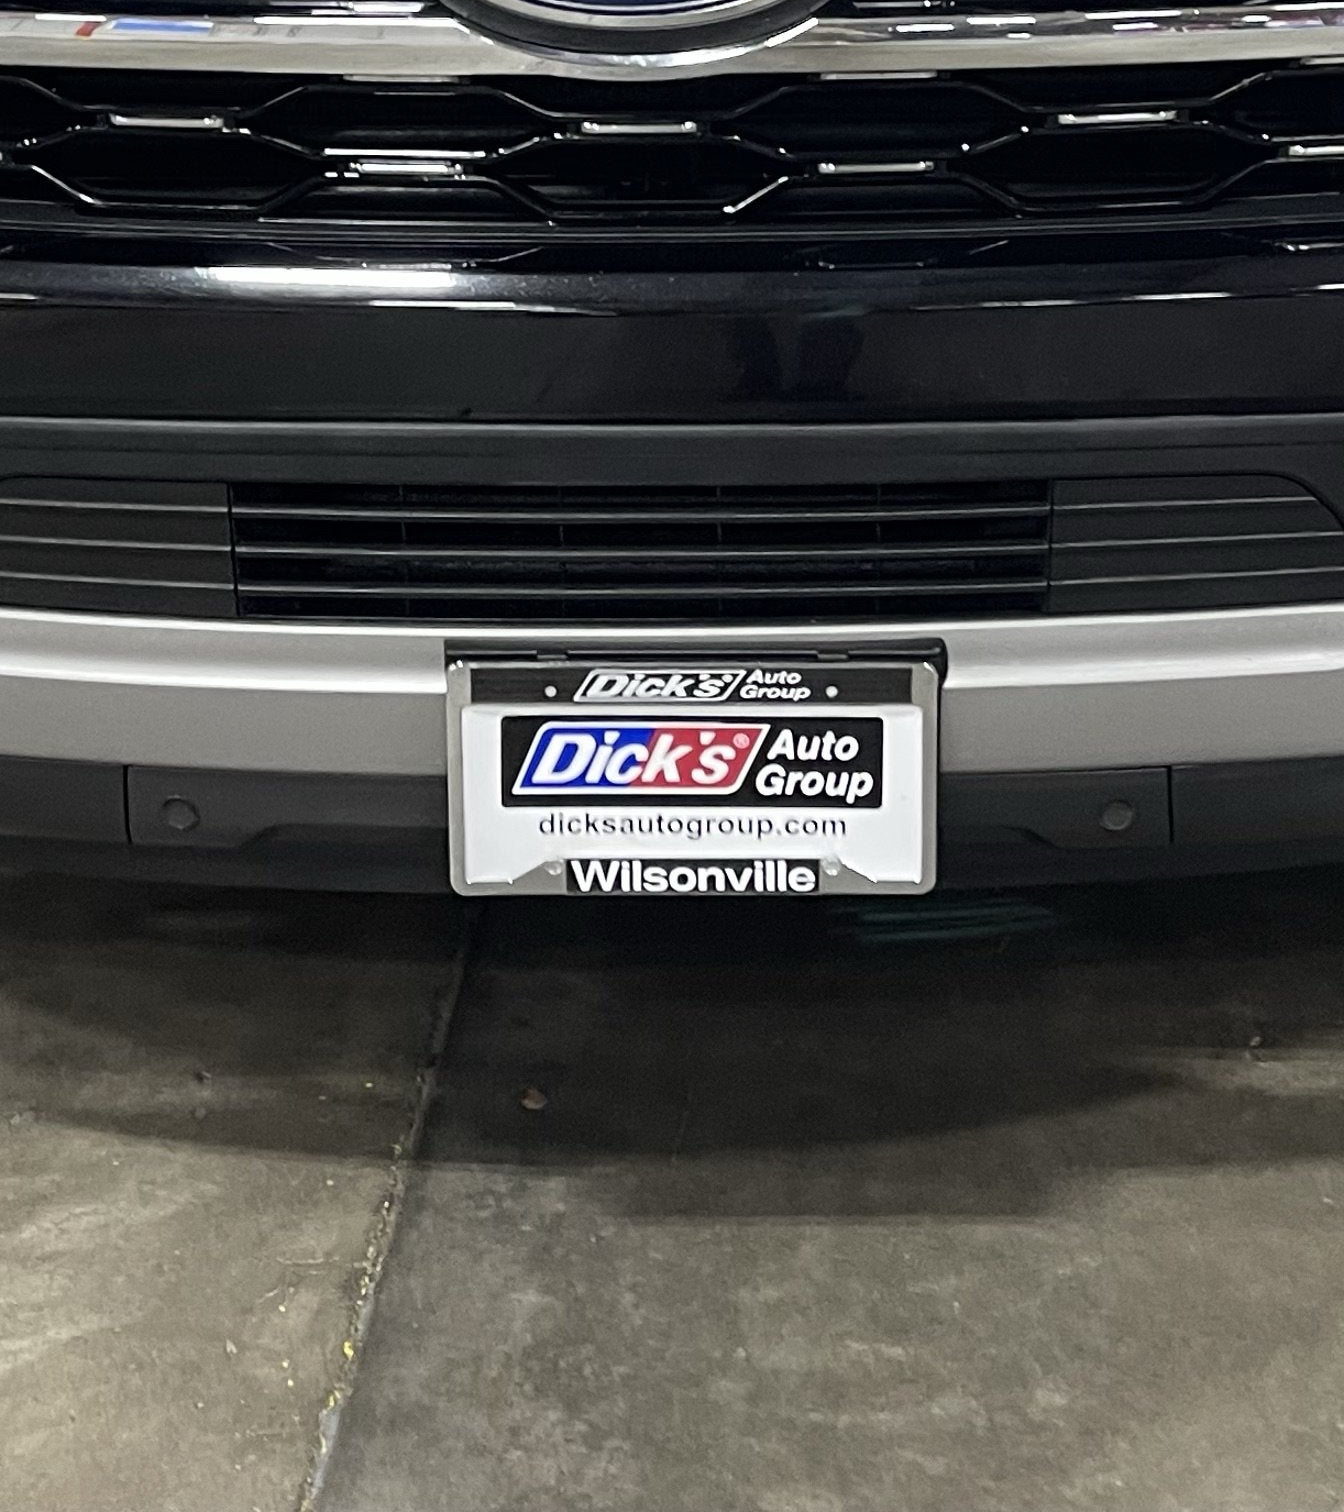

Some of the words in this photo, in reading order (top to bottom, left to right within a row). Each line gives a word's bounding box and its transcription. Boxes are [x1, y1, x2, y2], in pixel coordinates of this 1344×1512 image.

[586, 673, 726, 698] Dick's
[745, 669, 802, 684] Auto
[739, 685, 811, 701] Group
[531, 730, 737, 785] Dick's
[766, 729, 860, 761] Auto
[755, 764, 874, 804] Group
[538, 813, 847, 839] dicksautogroup.com
[570, 859, 816, 893] Wilsonville
